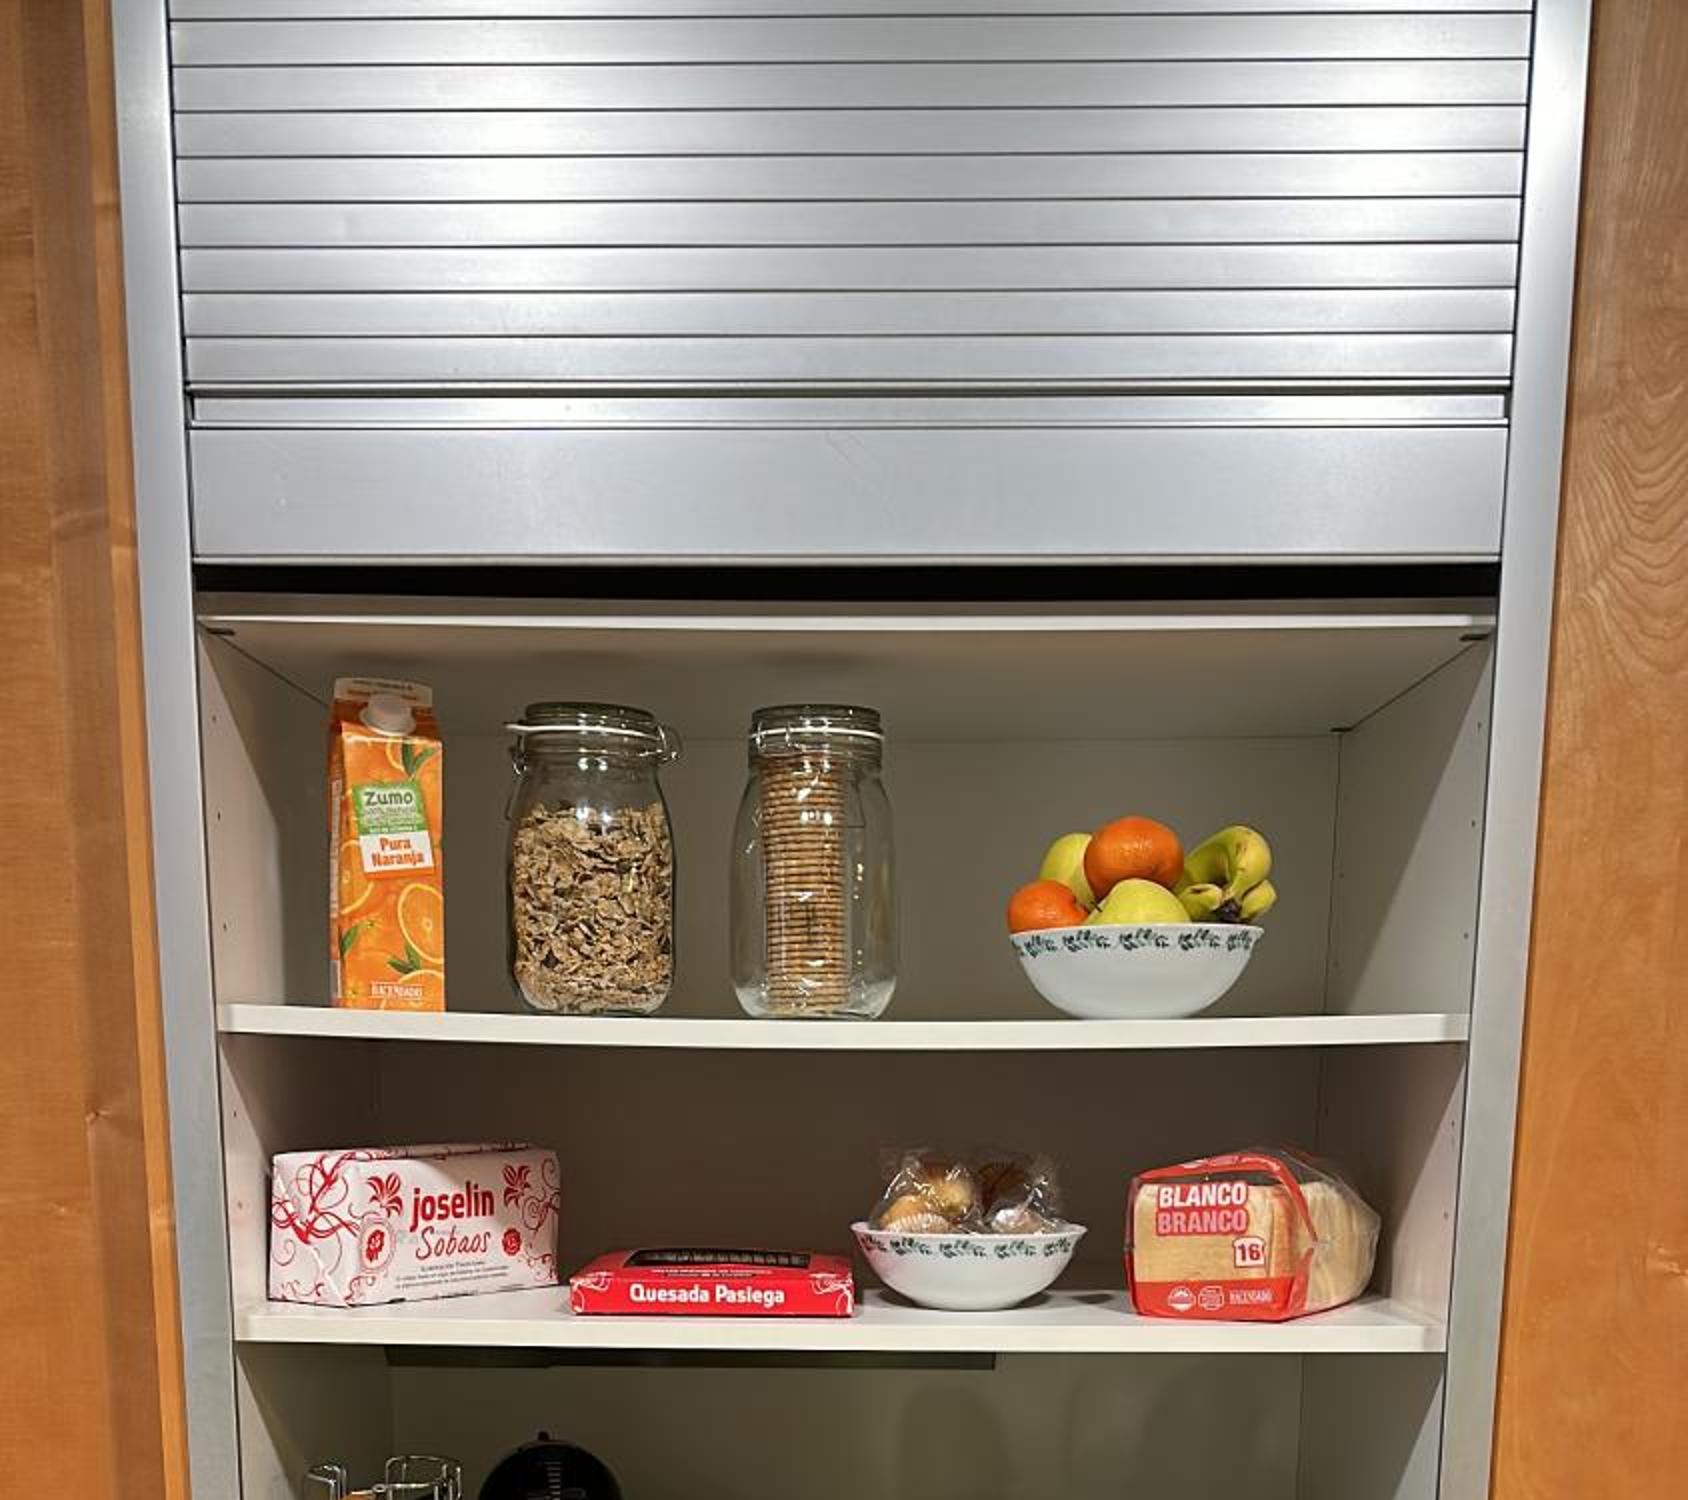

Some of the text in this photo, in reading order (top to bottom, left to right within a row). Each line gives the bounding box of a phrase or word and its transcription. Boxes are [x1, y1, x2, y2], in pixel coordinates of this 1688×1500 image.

[364, 791, 413, 806] Zumo
[379, 837, 411, 851] Pura
[372, 852, 424, 867] Naranja
[410, 1180, 495, 1233] joselin
[1160, 1183, 1246, 1207] BLANCO
[1158, 1209, 1247, 1234] BRANCO
[416, 1225, 491, 1261] Sobaos
[1238, 1243, 1260, 1261] 16
[629, 1283, 785, 1308] Quesada Pasiega
